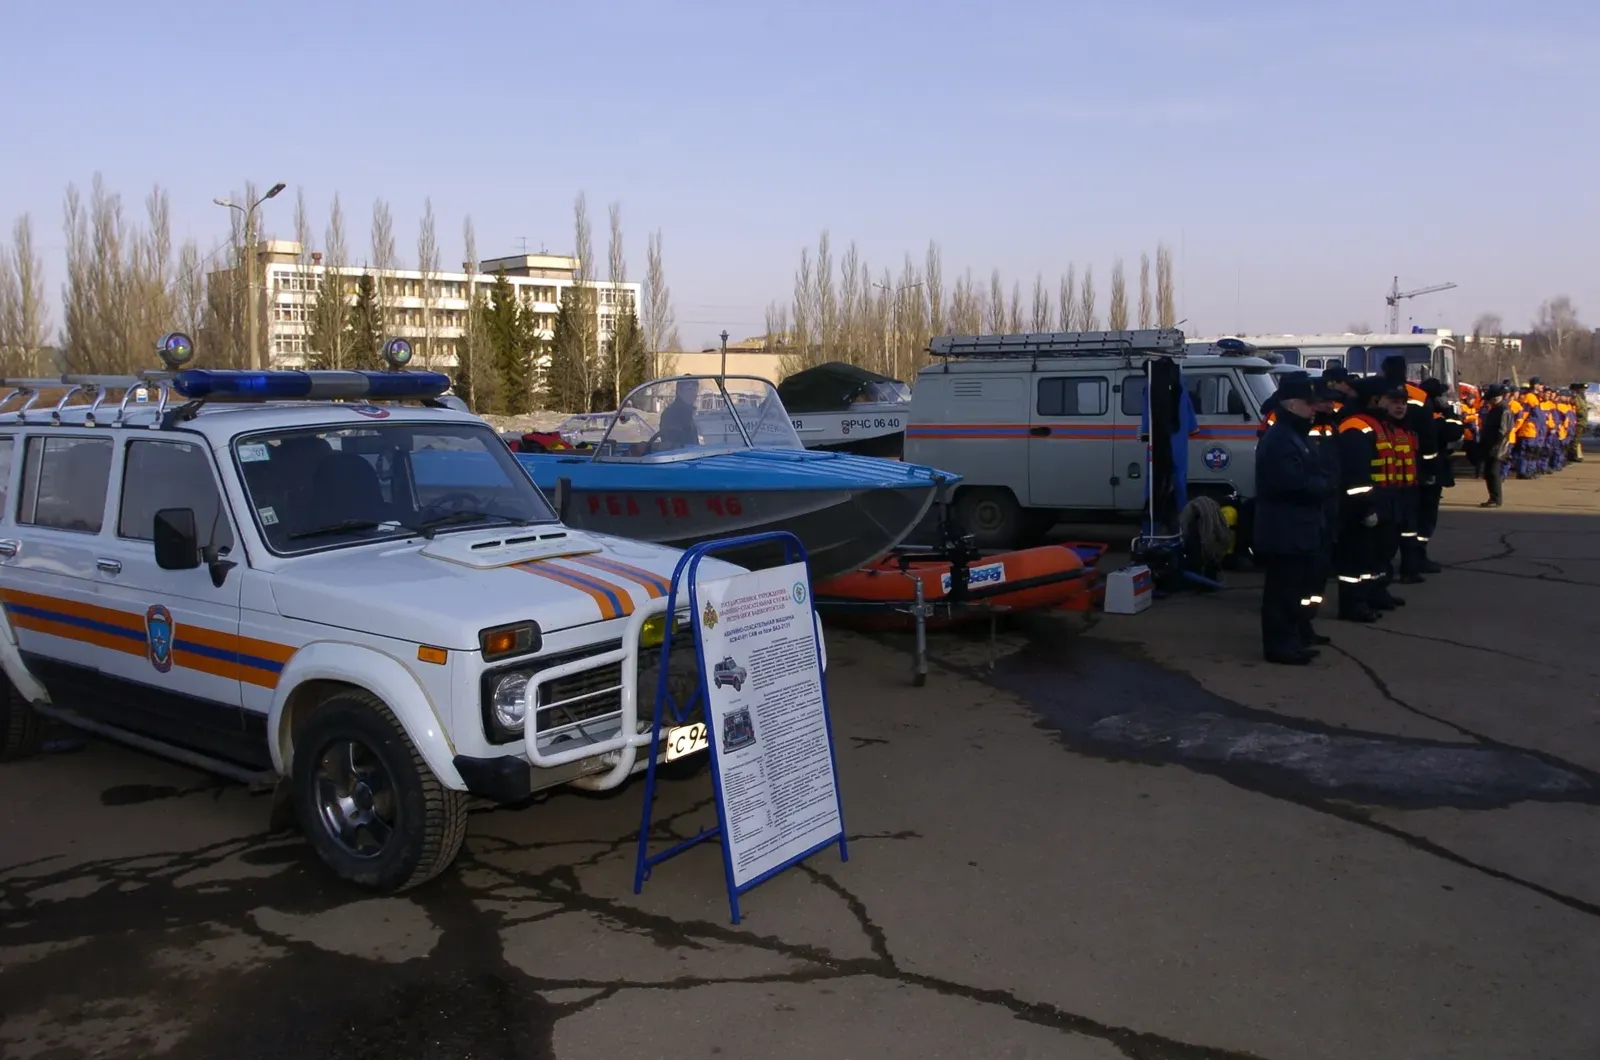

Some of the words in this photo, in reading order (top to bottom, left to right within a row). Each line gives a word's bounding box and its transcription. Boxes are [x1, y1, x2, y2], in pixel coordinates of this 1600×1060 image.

[850, 419, 871, 429] РЧС
[874, 418, 886, 428] 06
[887, 418, 900, 428] 40
